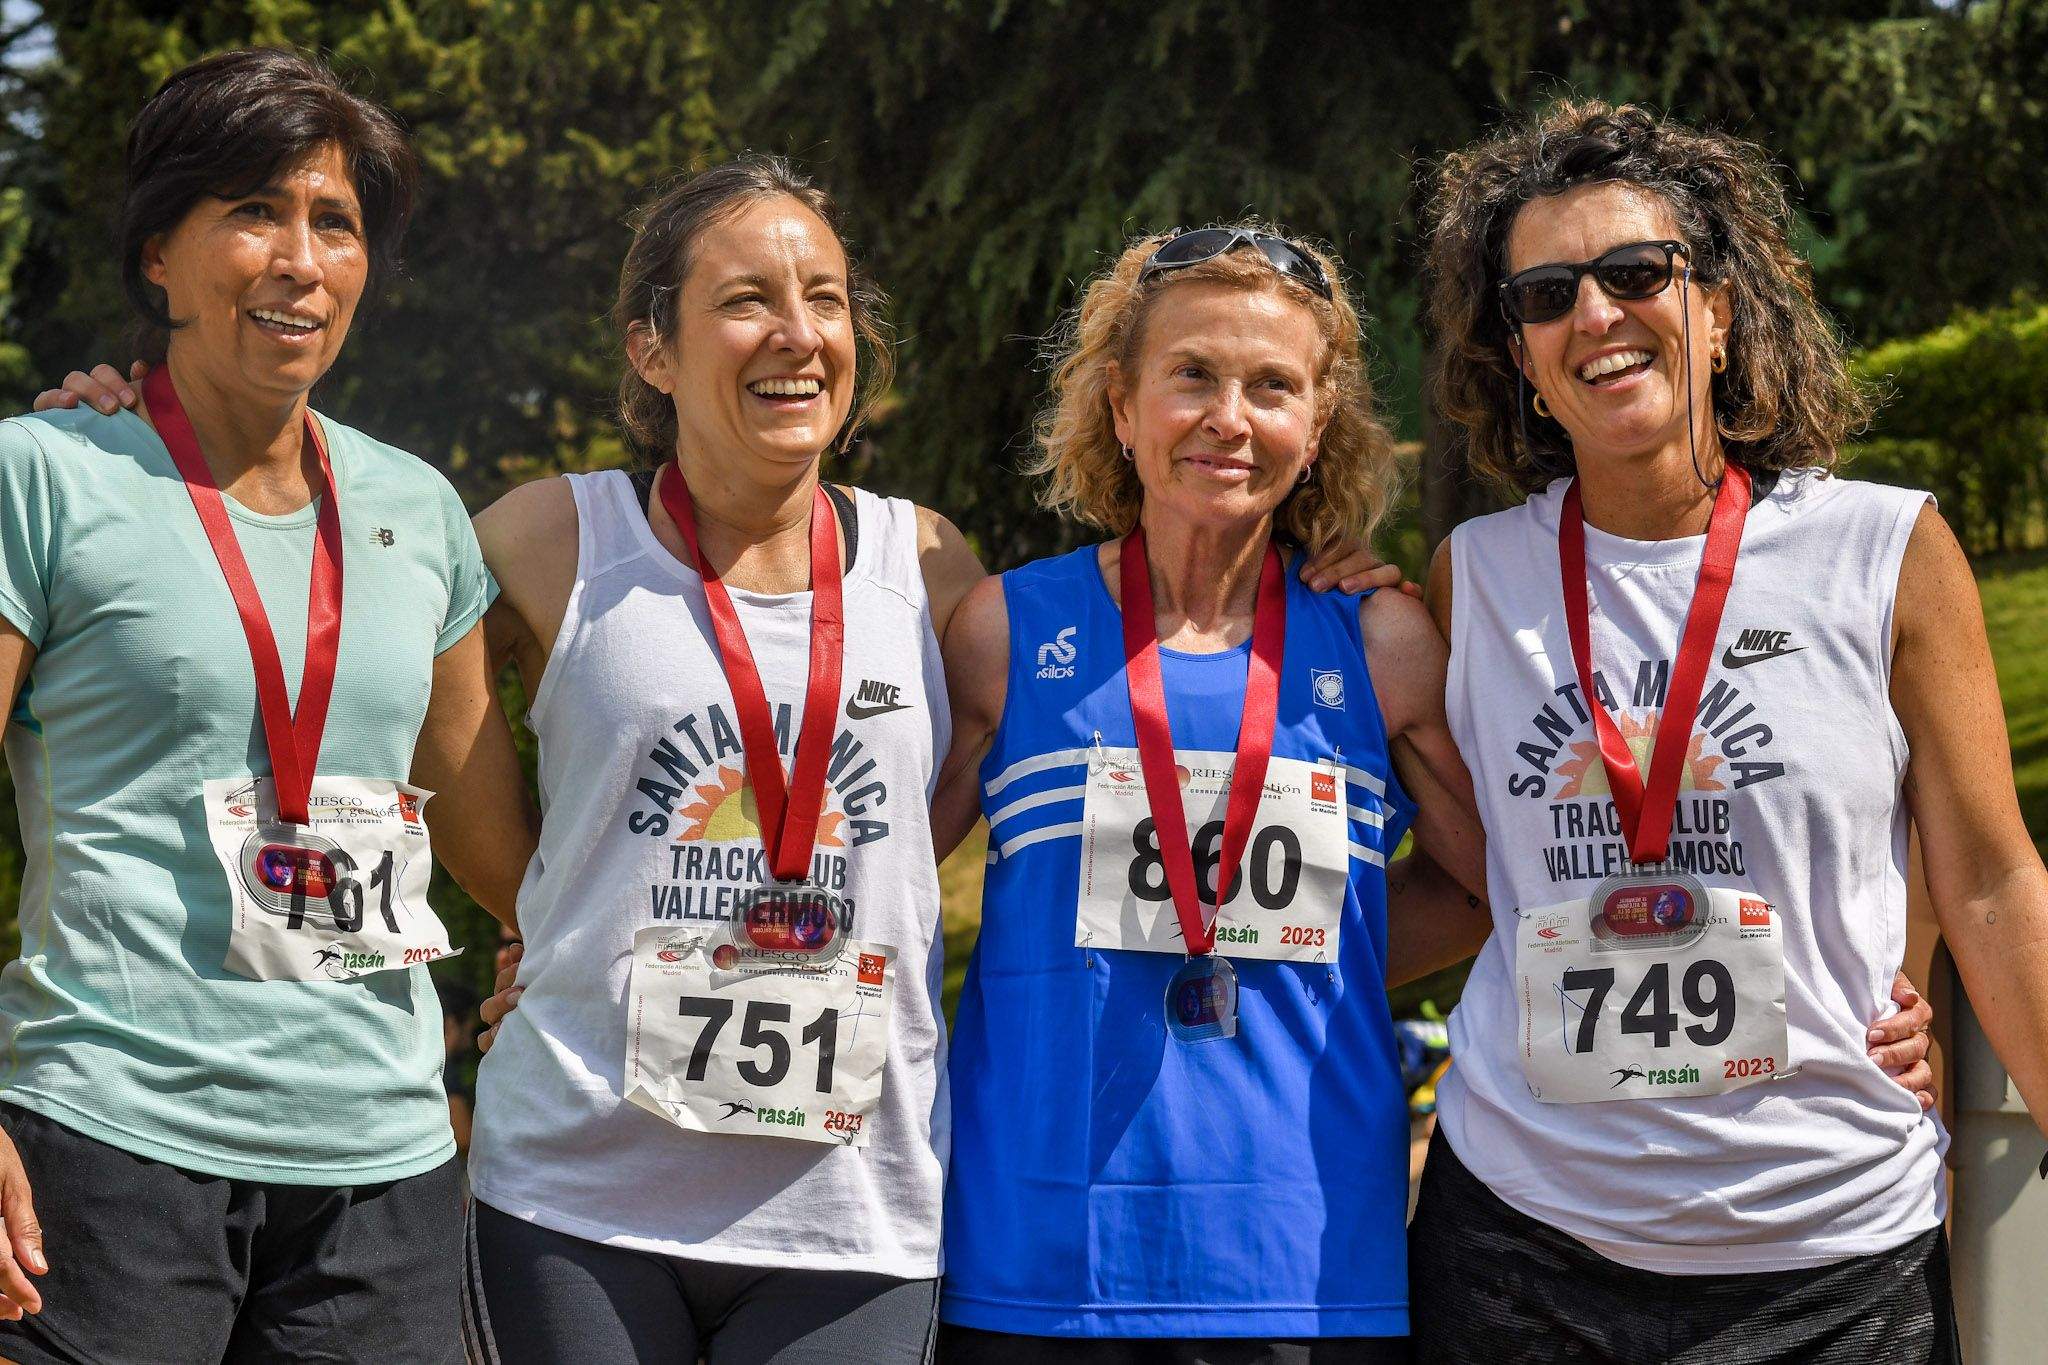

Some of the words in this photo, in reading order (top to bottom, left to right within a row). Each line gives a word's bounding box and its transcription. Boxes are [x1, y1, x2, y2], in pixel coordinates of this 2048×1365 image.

[1734, 629, 1791, 652] NIKE
[856, 679, 901, 706] NIKE
[1508, 670, 1620, 799] SANTA
[1633, 660, 1785, 790] MNICA
[628, 703, 743, 837] SANTA
[767, 701, 889, 848] MNICA
[1192, 768, 1232, 779] RIES
[335, 807, 344, 817] y
[349, 806, 395, 817] gestión
[1310, 801, 1338, 811] Comunidad
[1319, 808, 1338, 816] Madrid
[1549, 801, 1624, 839] TRAC
[1671, 799, 1731, 835] LUB
[669, 845, 766, 883] TRACK
[1128, 816, 1302, 911] 860
[1215, 923, 1259, 944] asán
[1279, 925, 1326, 947] 2023
[343, 949, 386, 970] rasán
[740, 948, 810, 963] RIESGO
[855, 984, 884, 993] Comunidad
[863, 991, 883, 999] Madrid
[1563, 959, 1736, 1054] 749
[678, 996, 839, 1094] 751
[1648, 1063, 1700, 1086] rasán
[1723, 1057, 1776, 1079] 2023
[757, 1106, 806, 1128] rasán
[823, 1110, 865, 1132] 2023
